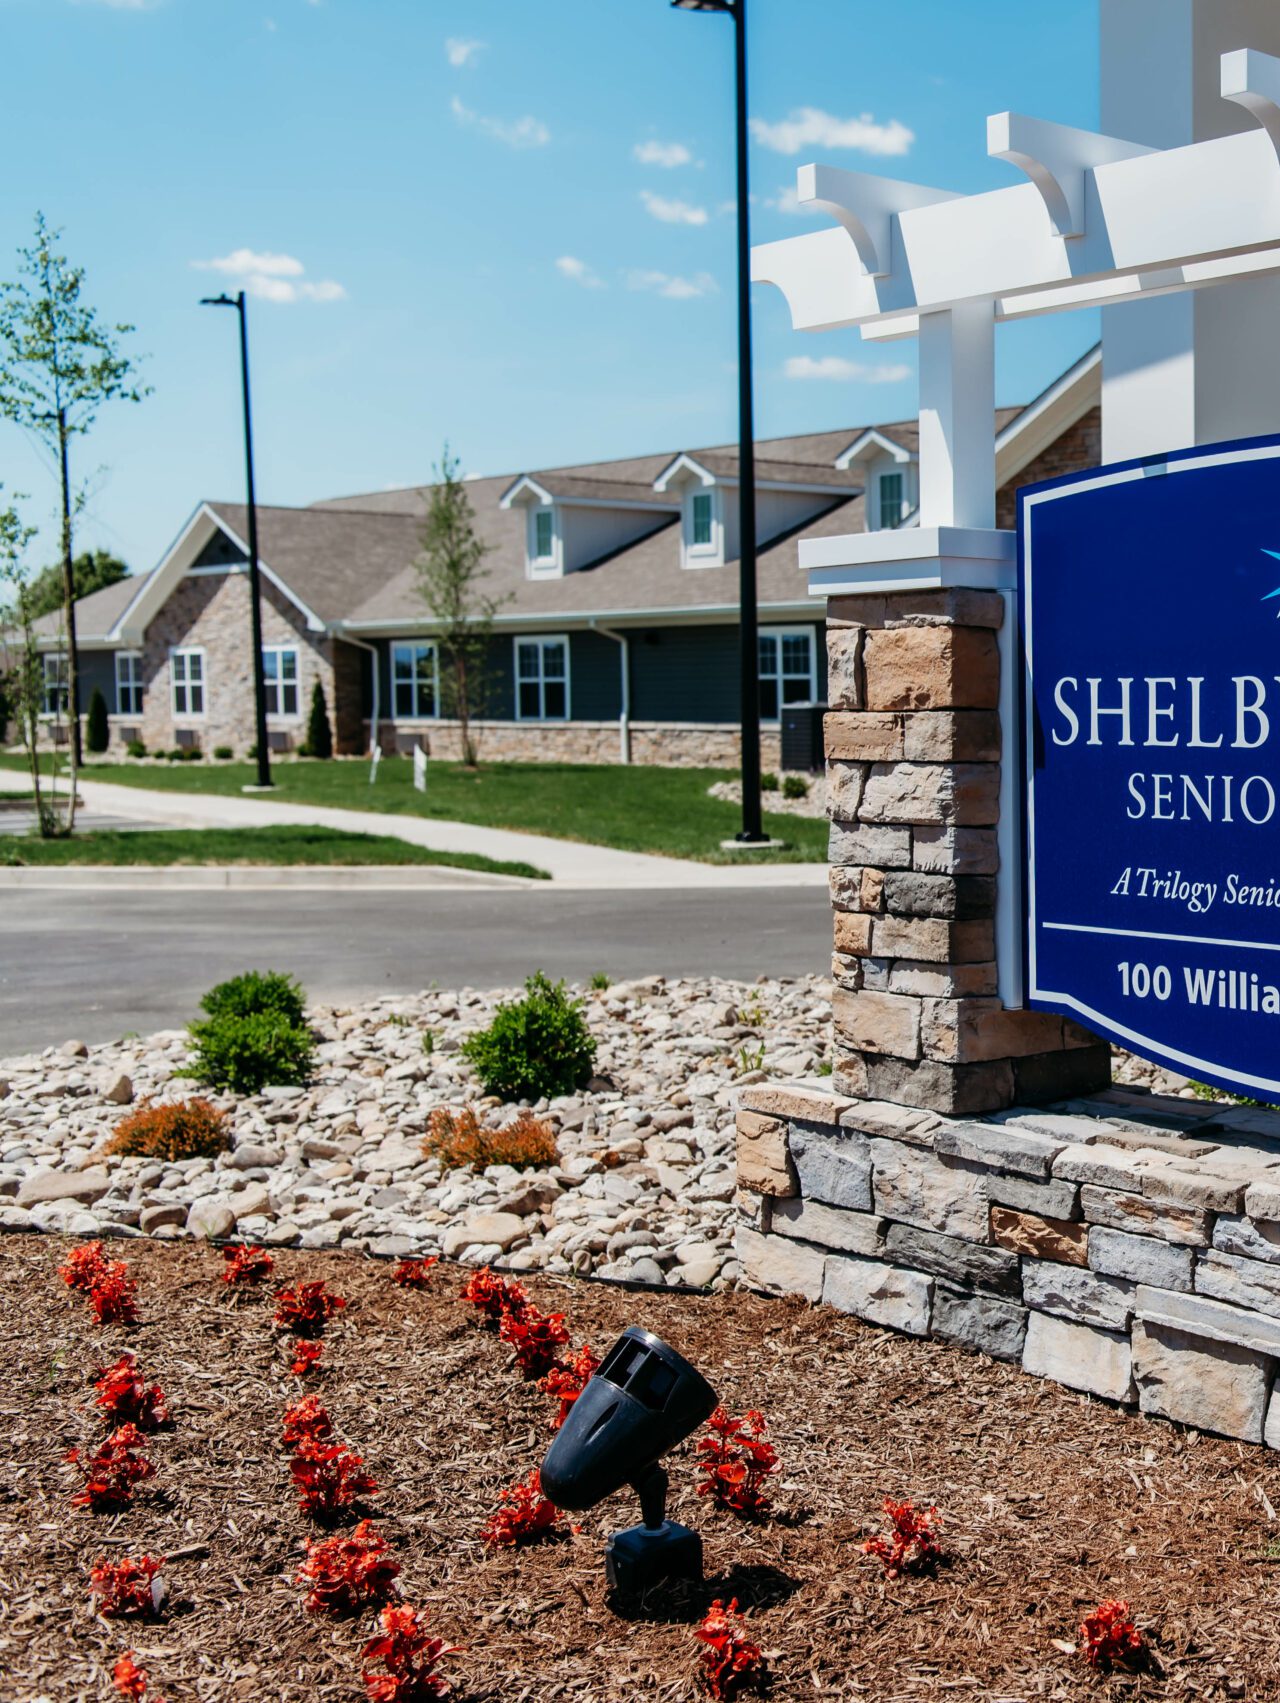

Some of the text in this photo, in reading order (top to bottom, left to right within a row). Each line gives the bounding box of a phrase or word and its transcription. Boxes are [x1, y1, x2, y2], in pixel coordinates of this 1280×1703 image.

[1110, 867, 1132, 896] A
[1135, 866, 1218, 913] Trilogy
[1117, 961, 1172, 1001] 100
